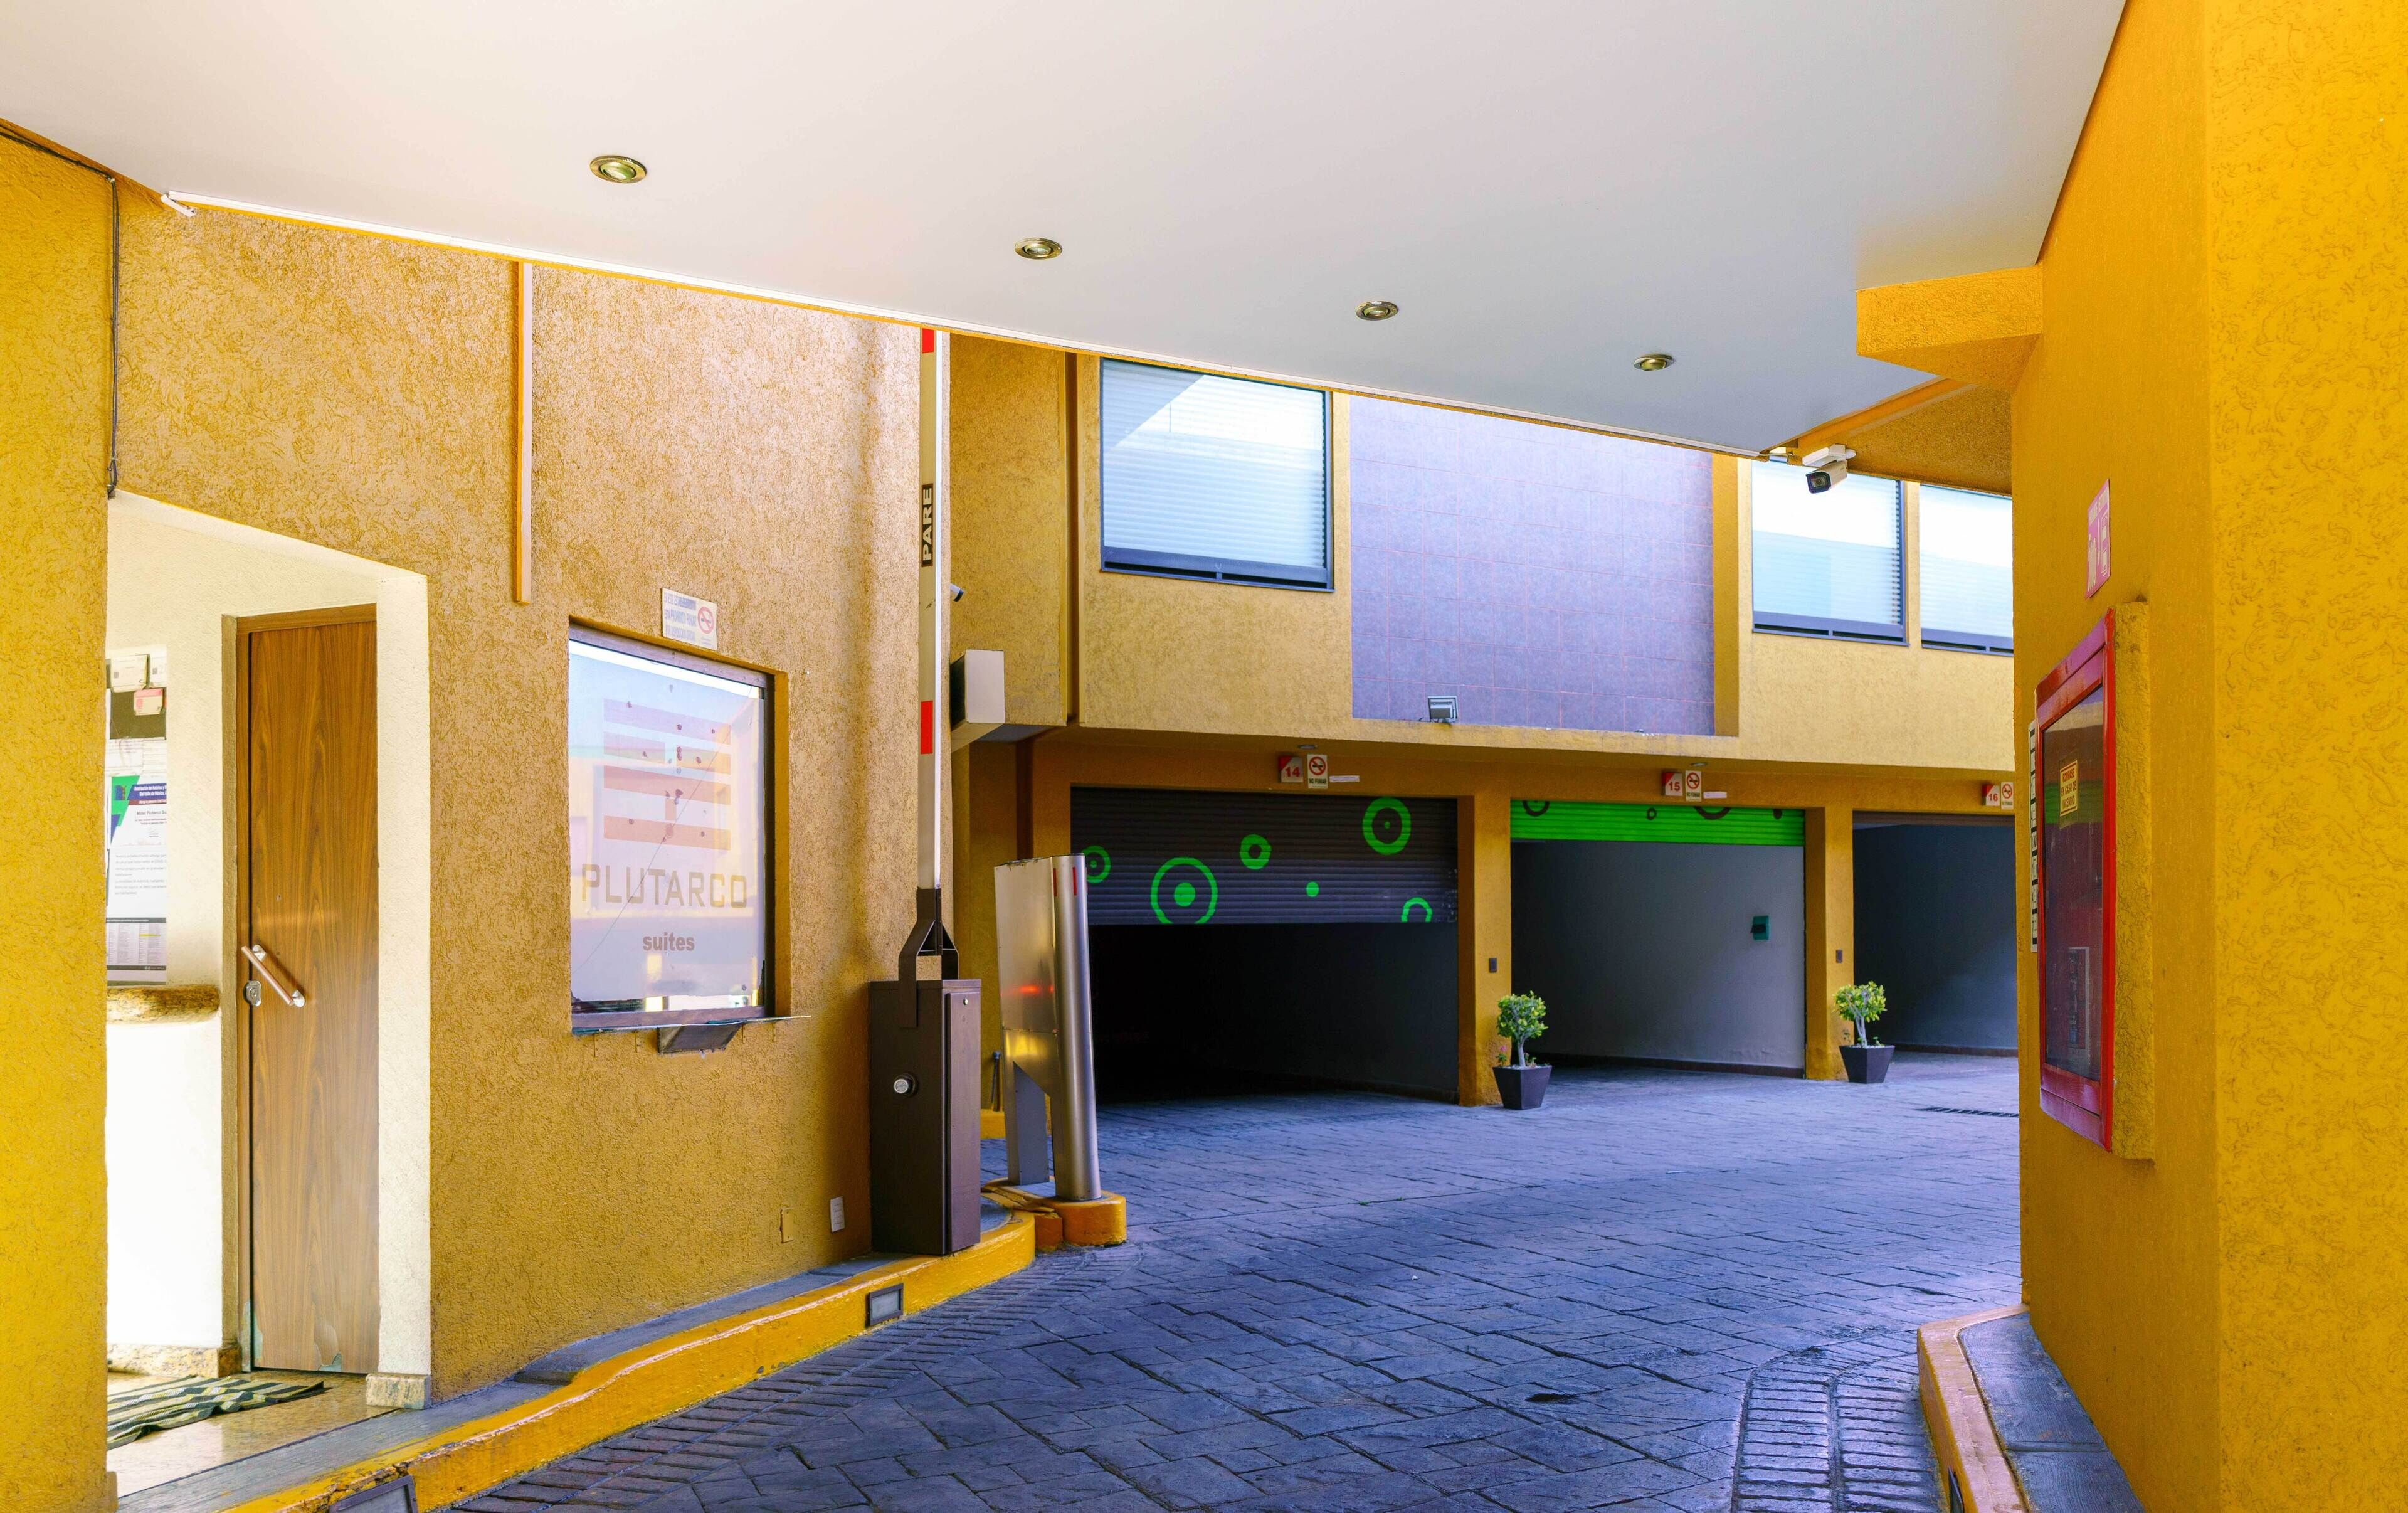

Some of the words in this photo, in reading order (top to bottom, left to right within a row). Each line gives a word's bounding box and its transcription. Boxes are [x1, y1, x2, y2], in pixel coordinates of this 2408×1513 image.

[922, 487, 932, 561] PARE
[1286, 767, 1301, 777] 14
[1669, 782, 1681, 792] 15
[1988, 793, 1998, 802] 16
[582, 863, 747, 908] PLUTARCO
[643, 932, 695, 951] suites
